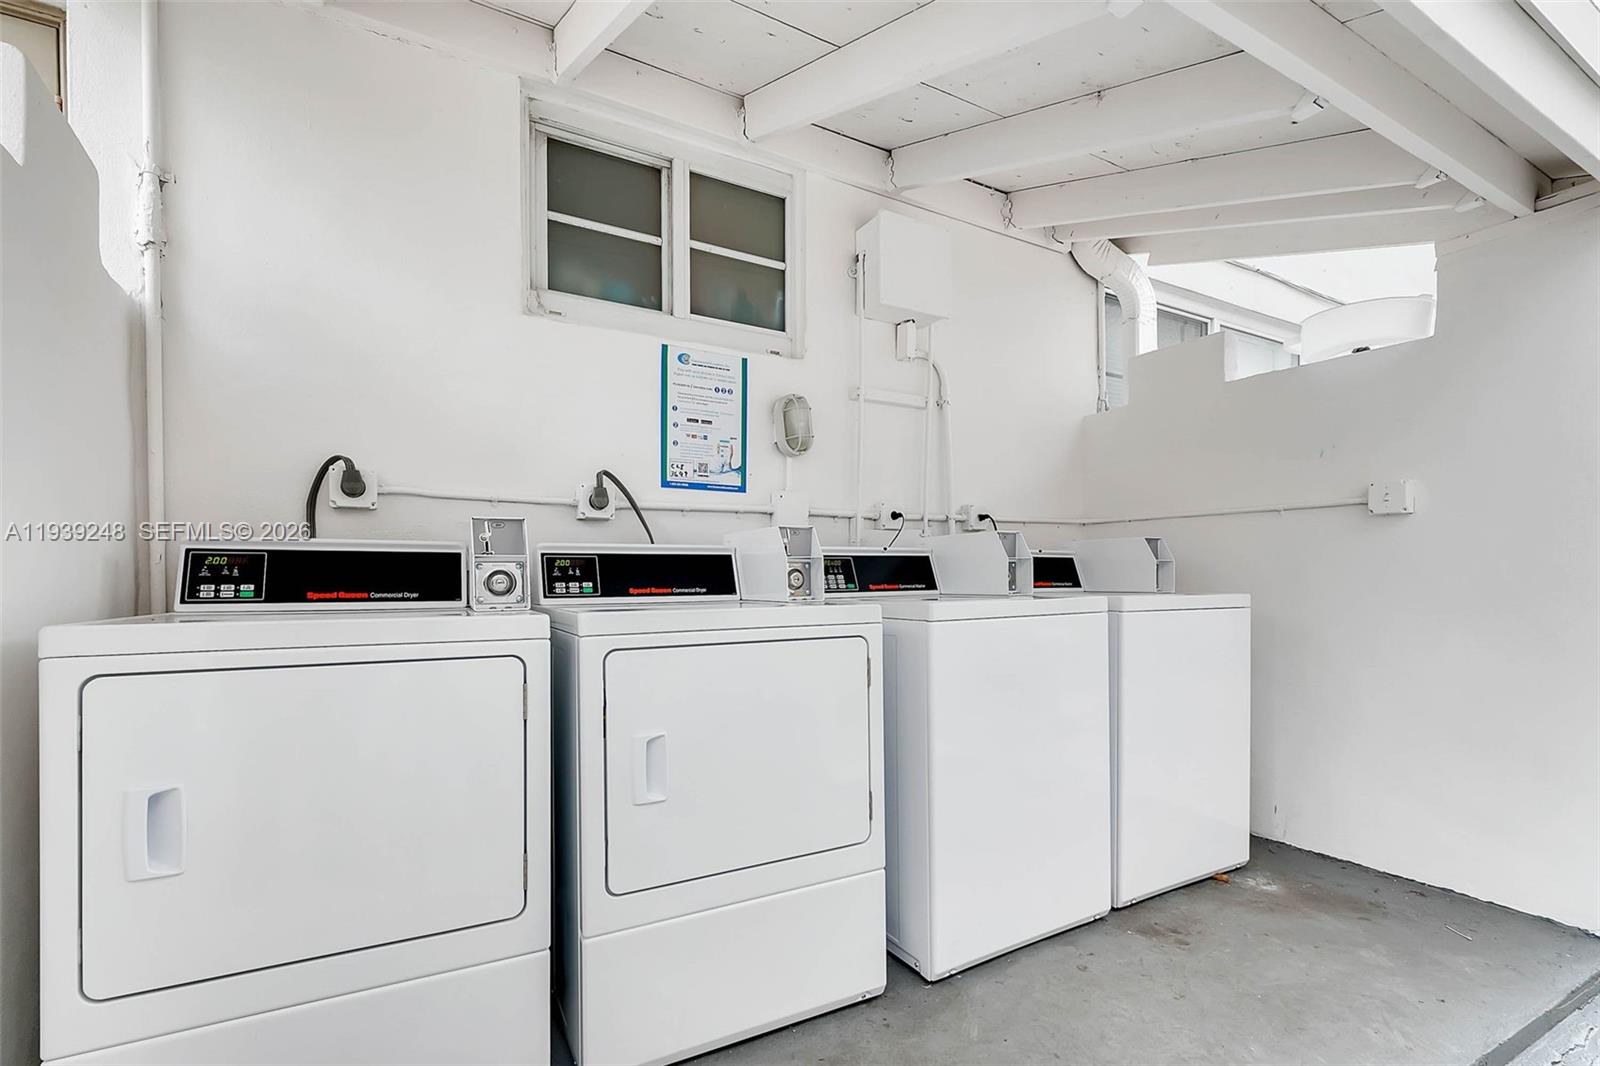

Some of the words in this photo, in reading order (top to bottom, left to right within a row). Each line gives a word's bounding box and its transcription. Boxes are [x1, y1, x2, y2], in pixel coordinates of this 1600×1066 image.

[307, 591, 337, 600] Speed
[339, 591, 368, 599] Queen
[404, 592, 419, 600] Dryer
